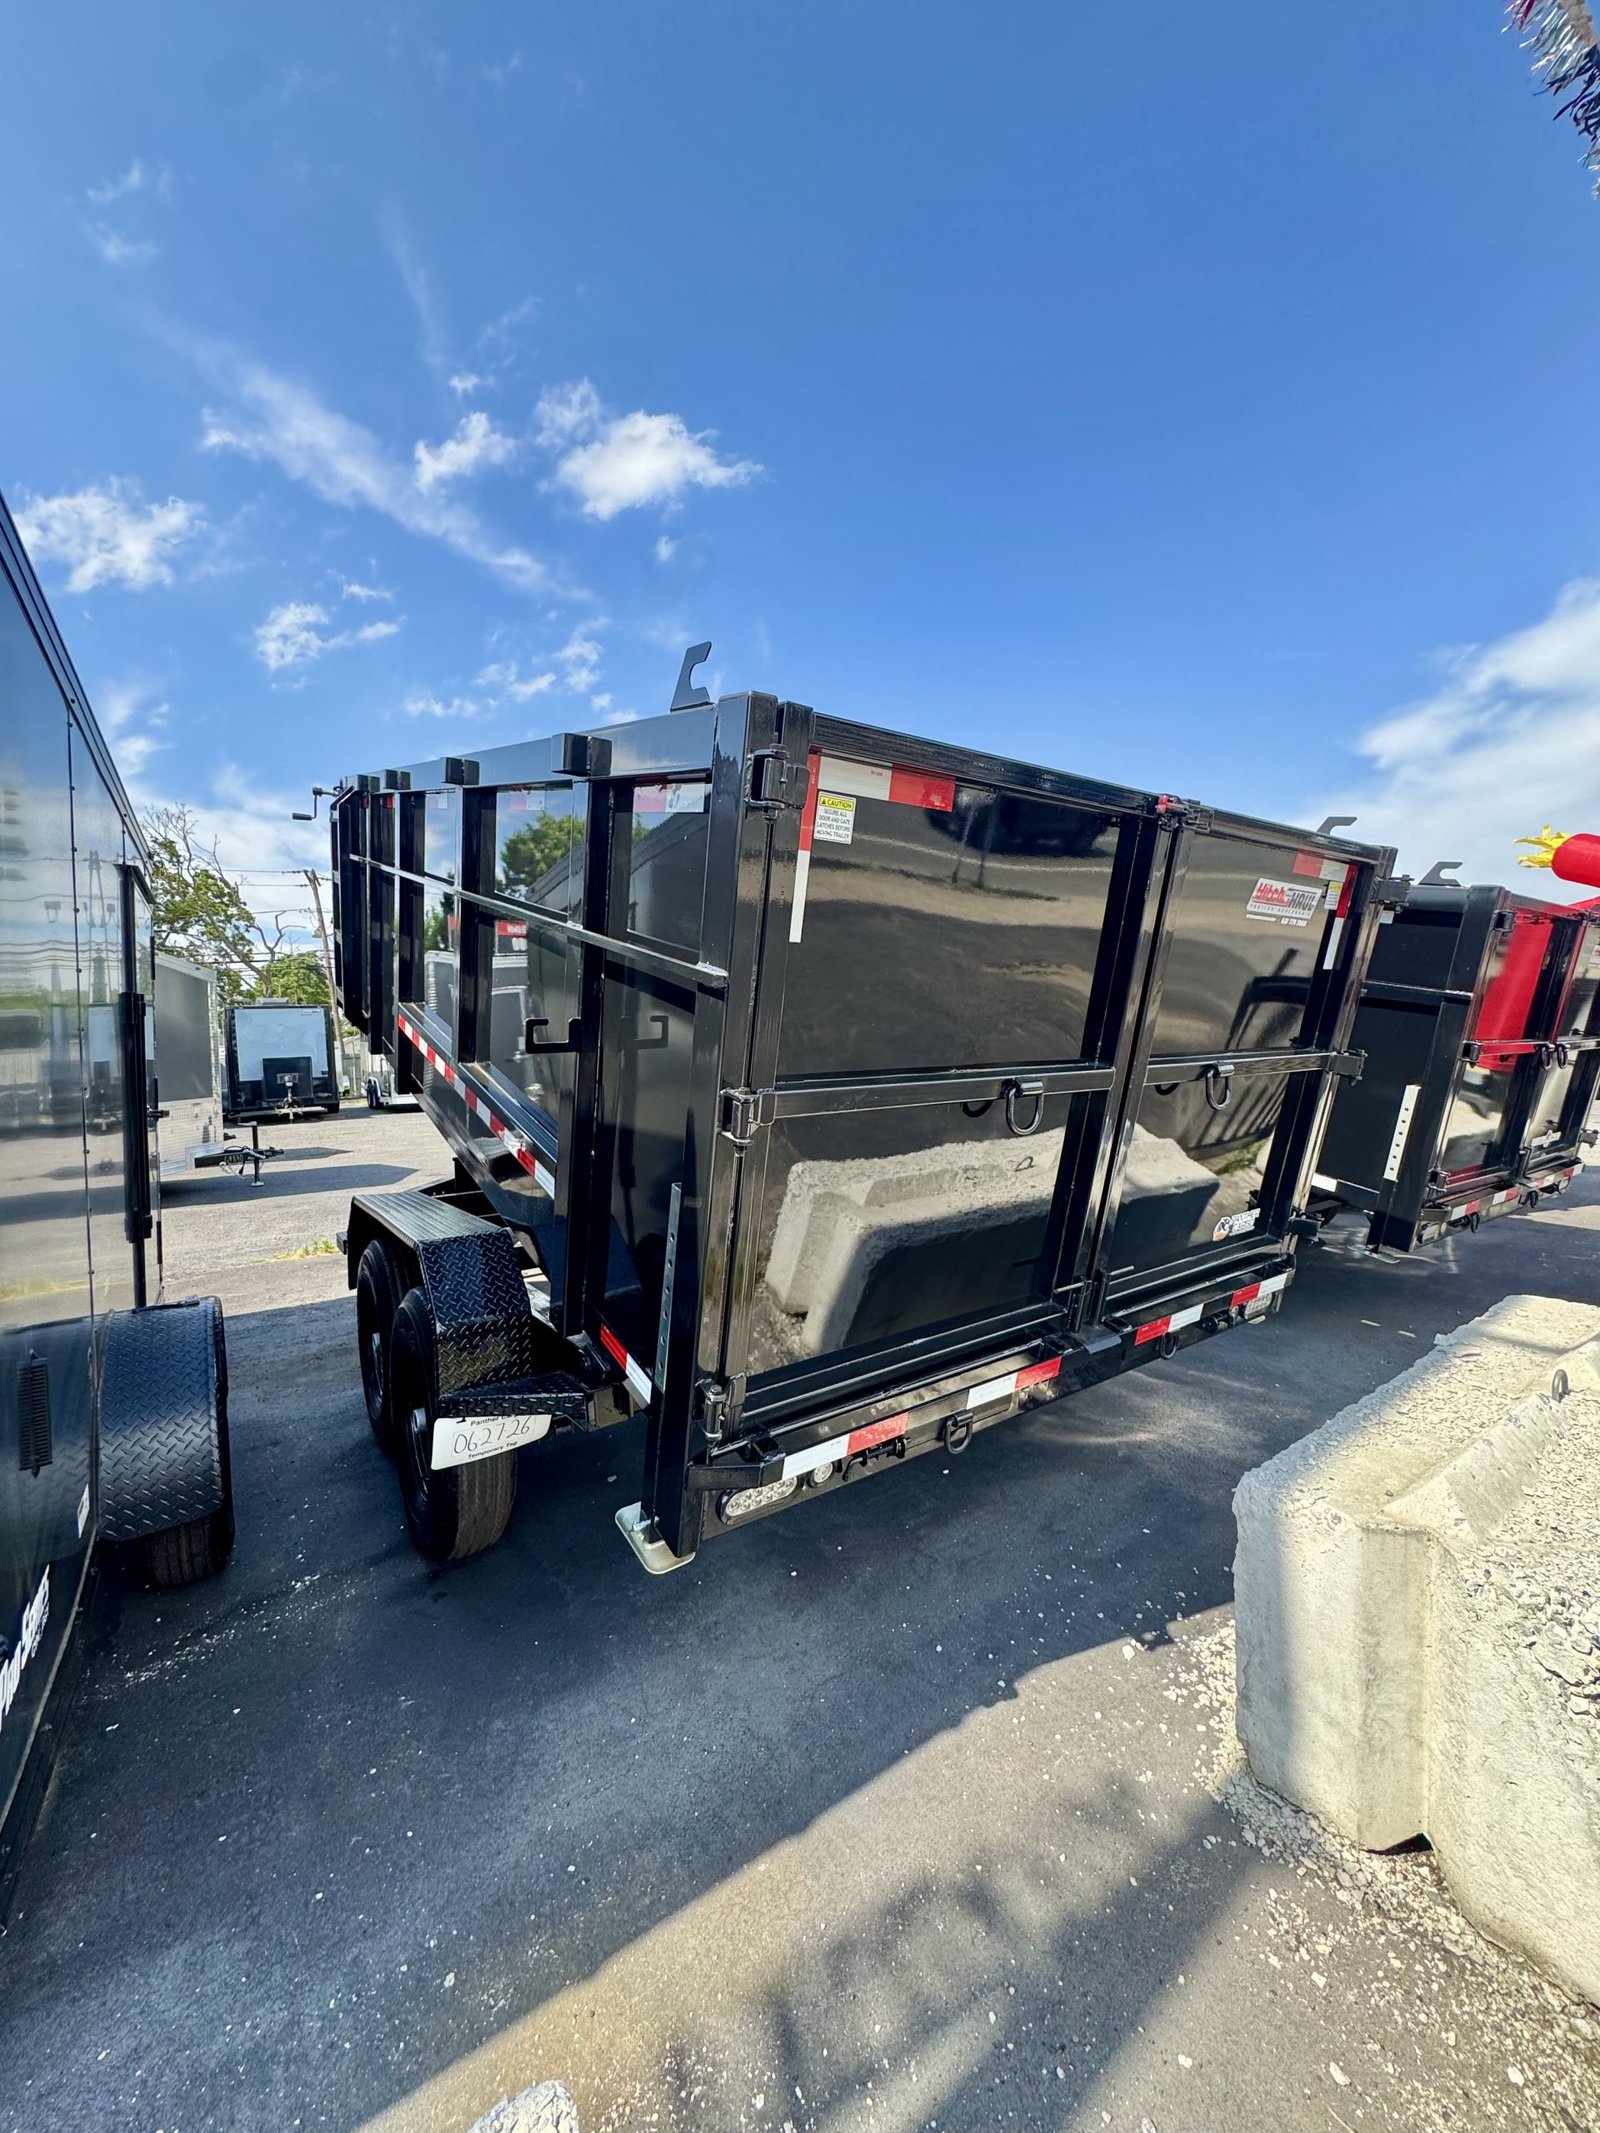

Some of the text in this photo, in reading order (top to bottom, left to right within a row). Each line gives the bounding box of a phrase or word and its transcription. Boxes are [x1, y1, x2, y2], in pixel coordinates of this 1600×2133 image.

[827, 799, 851, 808] CAUTION
[816, 821, 835, 830] LATCHES
[1256, 882, 1286, 900] Hitch
[1288, 891, 1316, 911] HAUL
[470, 1416, 499, 1427] Panther
[468, 1445, 504, 1459] Temporary
